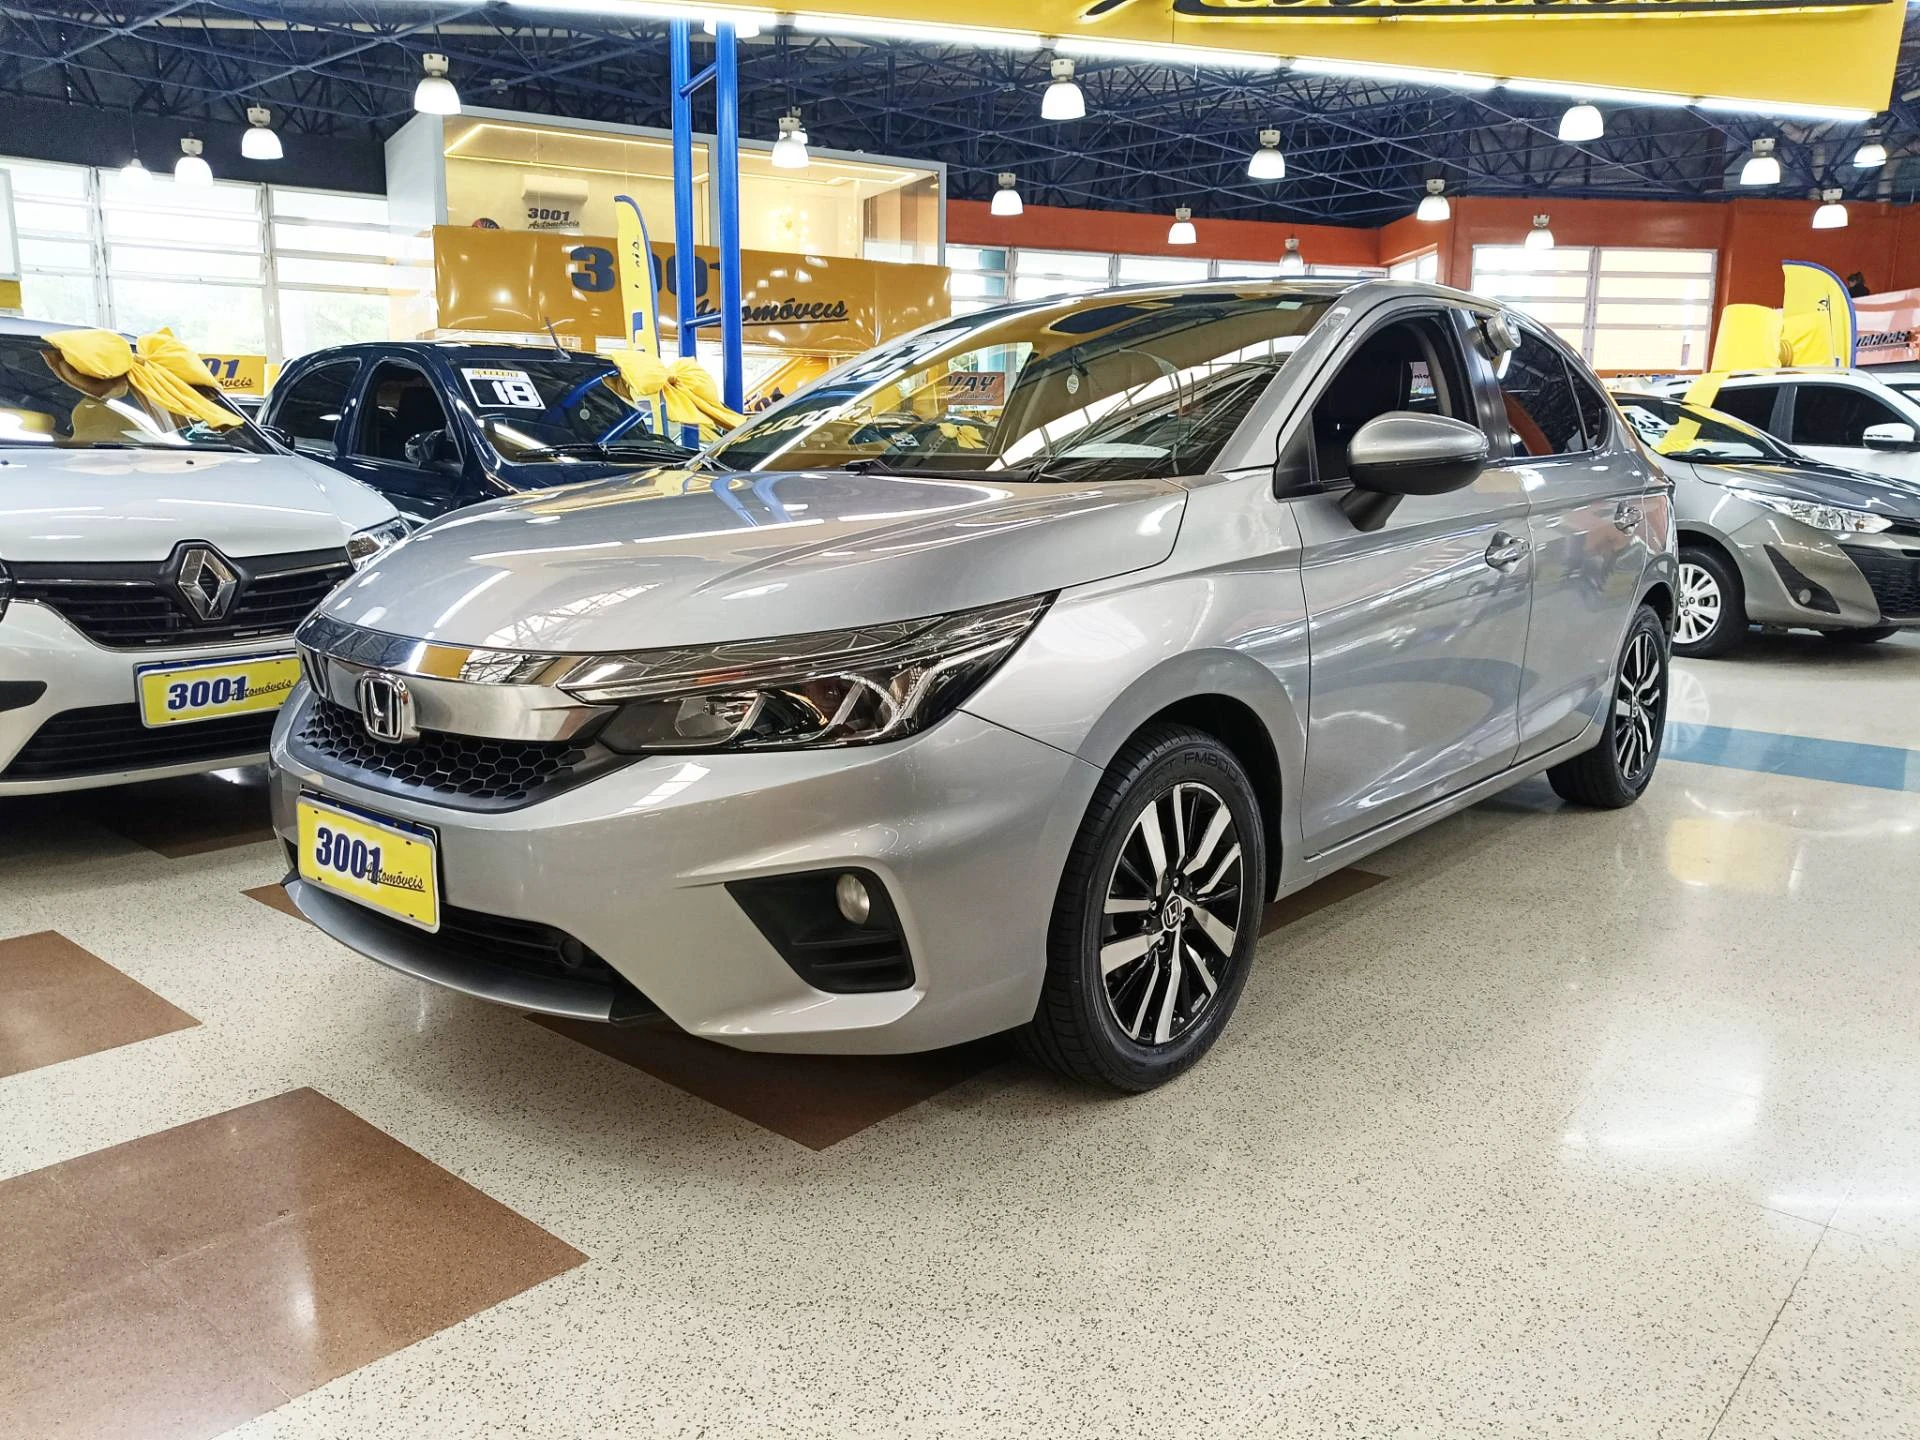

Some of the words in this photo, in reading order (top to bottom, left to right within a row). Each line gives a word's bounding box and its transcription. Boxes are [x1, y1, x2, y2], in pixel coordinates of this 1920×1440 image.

[527, 207, 570, 221] 3001
[695, 297, 849, 322] Aomóveis
[491, 380, 541, 408] 18
[168, 675, 247, 710] 3001
[316, 826, 381, 885] 3001
